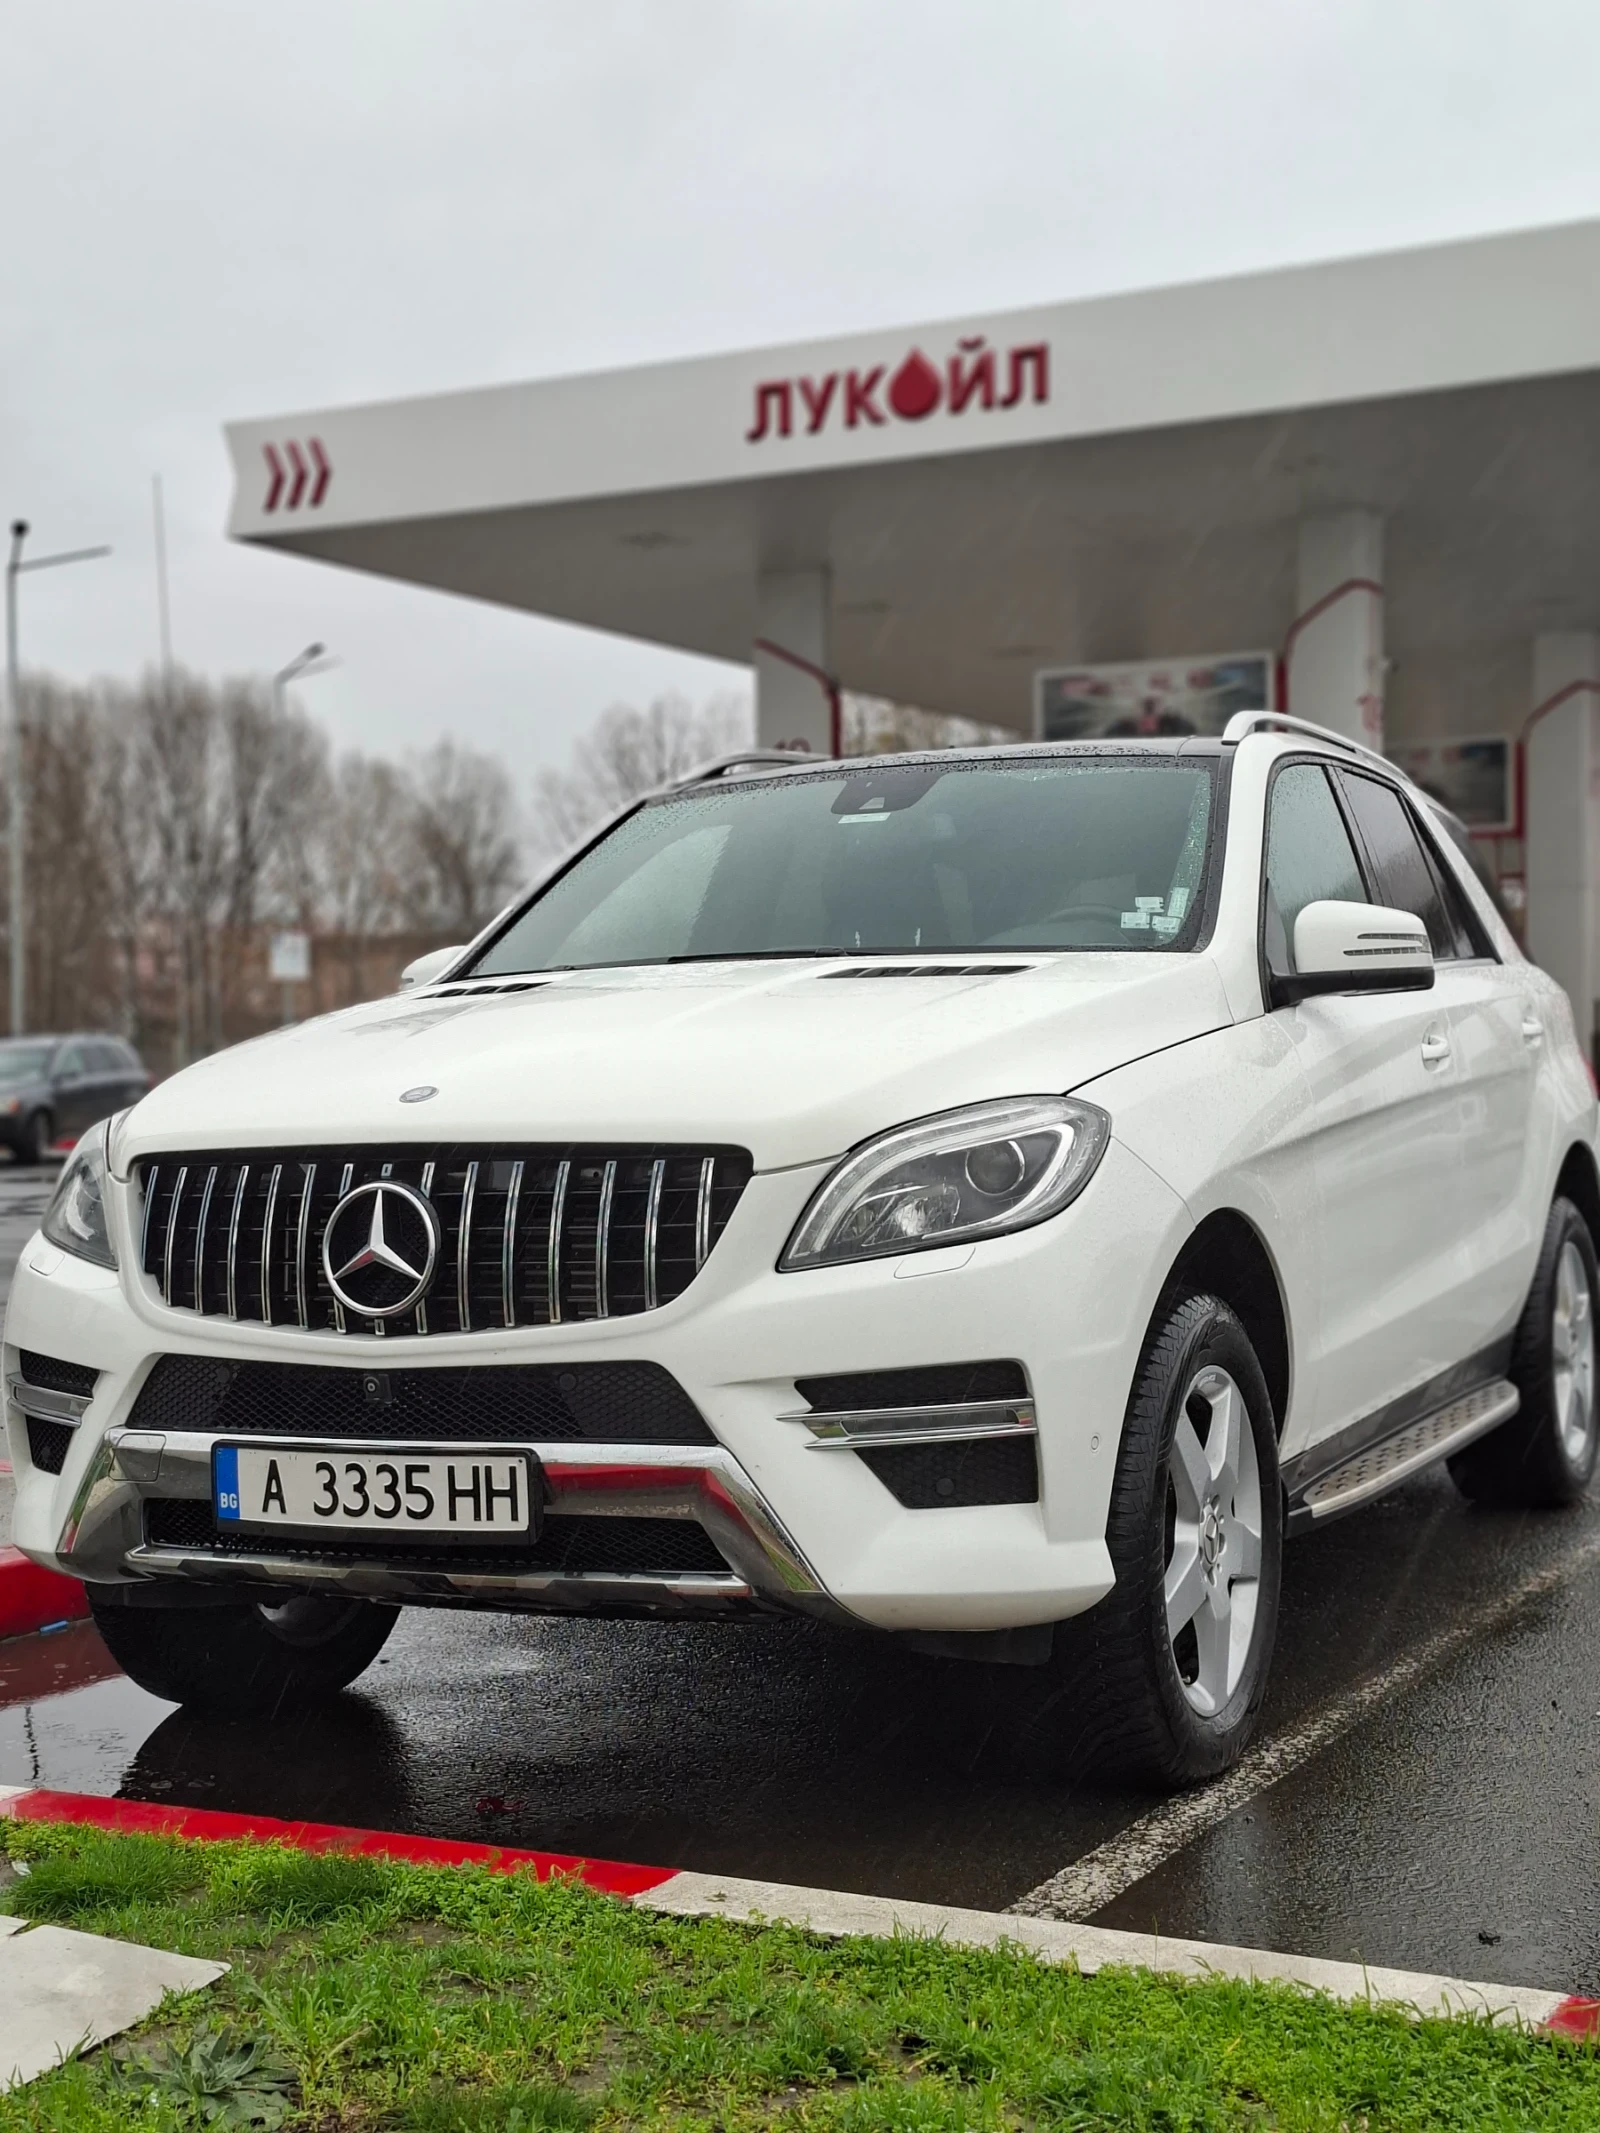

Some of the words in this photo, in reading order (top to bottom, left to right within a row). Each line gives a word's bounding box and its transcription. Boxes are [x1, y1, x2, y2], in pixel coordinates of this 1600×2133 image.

[220, 1492, 238, 1509] BG
[262, 1459, 287, 1514] A
[313, 1461, 435, 1520] 3335
